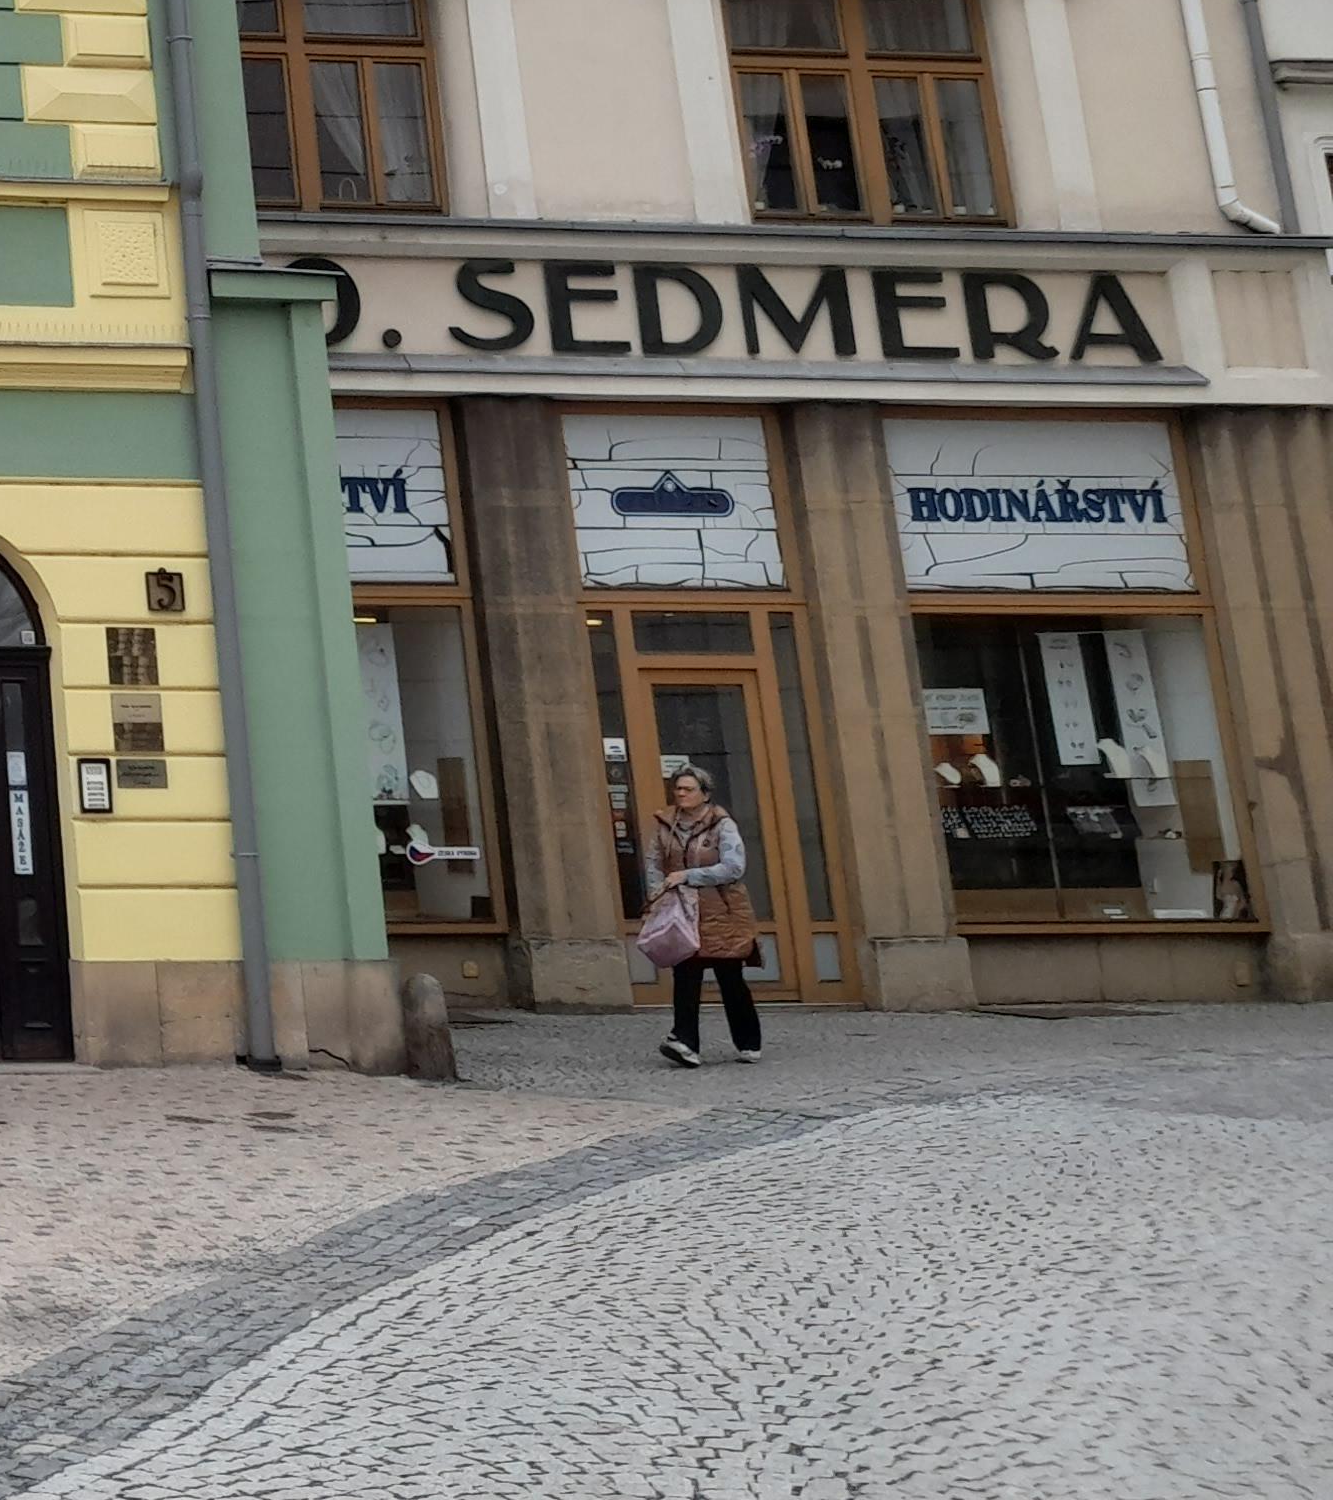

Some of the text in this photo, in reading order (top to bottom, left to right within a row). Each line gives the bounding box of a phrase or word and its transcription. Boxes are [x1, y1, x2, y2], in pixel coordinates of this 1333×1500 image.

[448, 257, 1164, 362] SEDMERA
[341, 468, 409, 513] TVÍ
[907, 479, 1167, 523] HODINÁŘSTVÍ
[156, 573, 176, 610] 5
